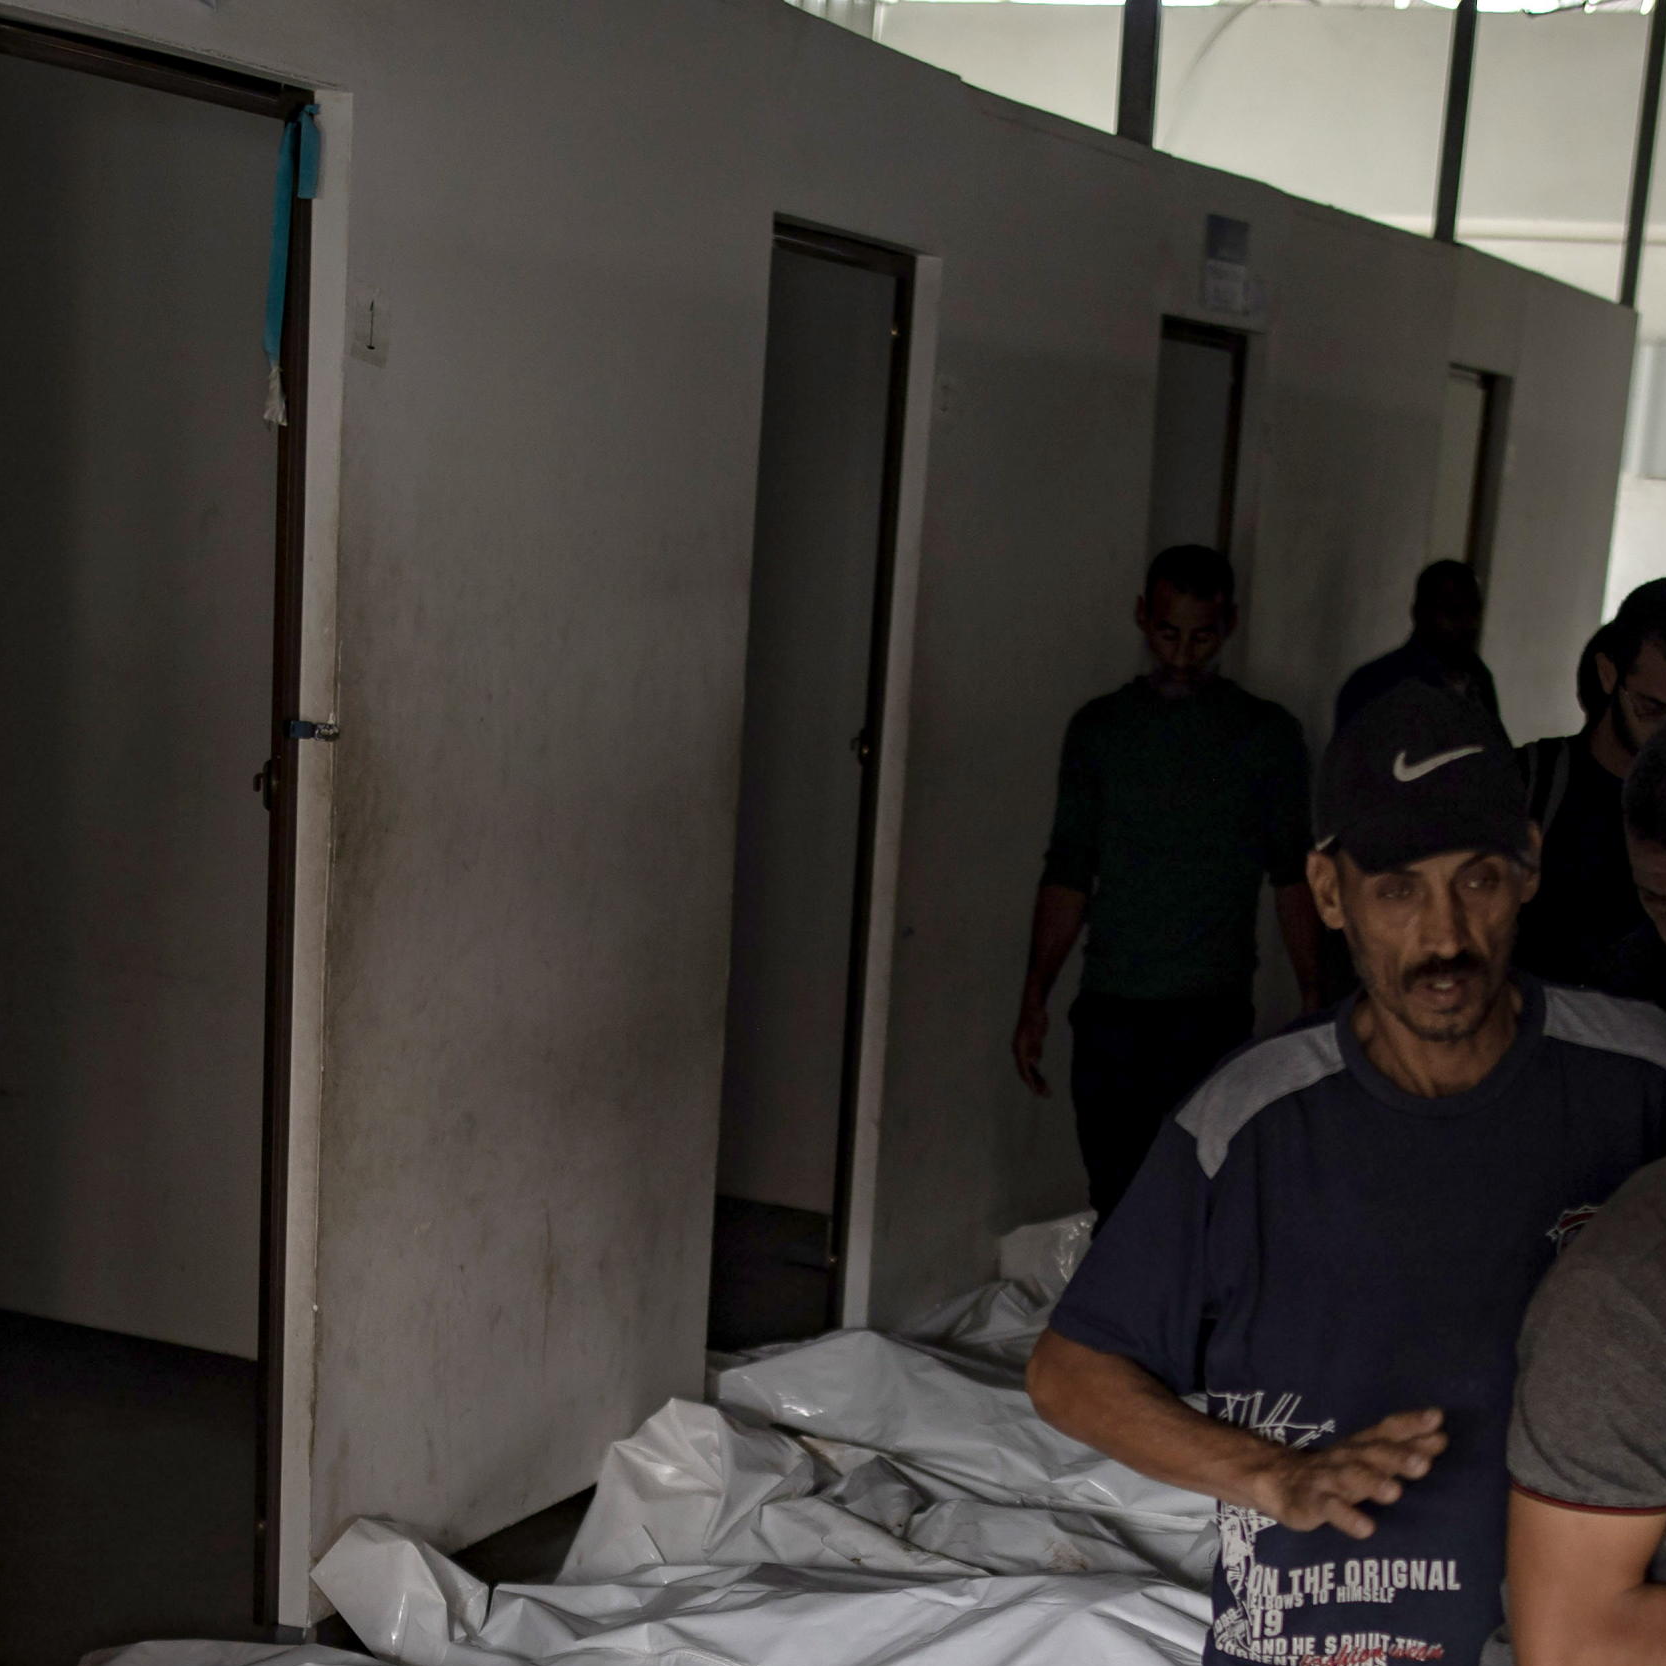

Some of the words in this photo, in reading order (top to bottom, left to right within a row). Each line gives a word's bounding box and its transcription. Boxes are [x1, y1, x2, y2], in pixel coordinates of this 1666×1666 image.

[1289, 1562, 1335, 1594] THE
[1344, 1558, 1461, 1591] ORIGNAL
[1337, 1586, 1396, 1604] HIMSELF
[1251, 1638, 1287, 1656] AND
[1292, 1636, 1317, 1655] HE
